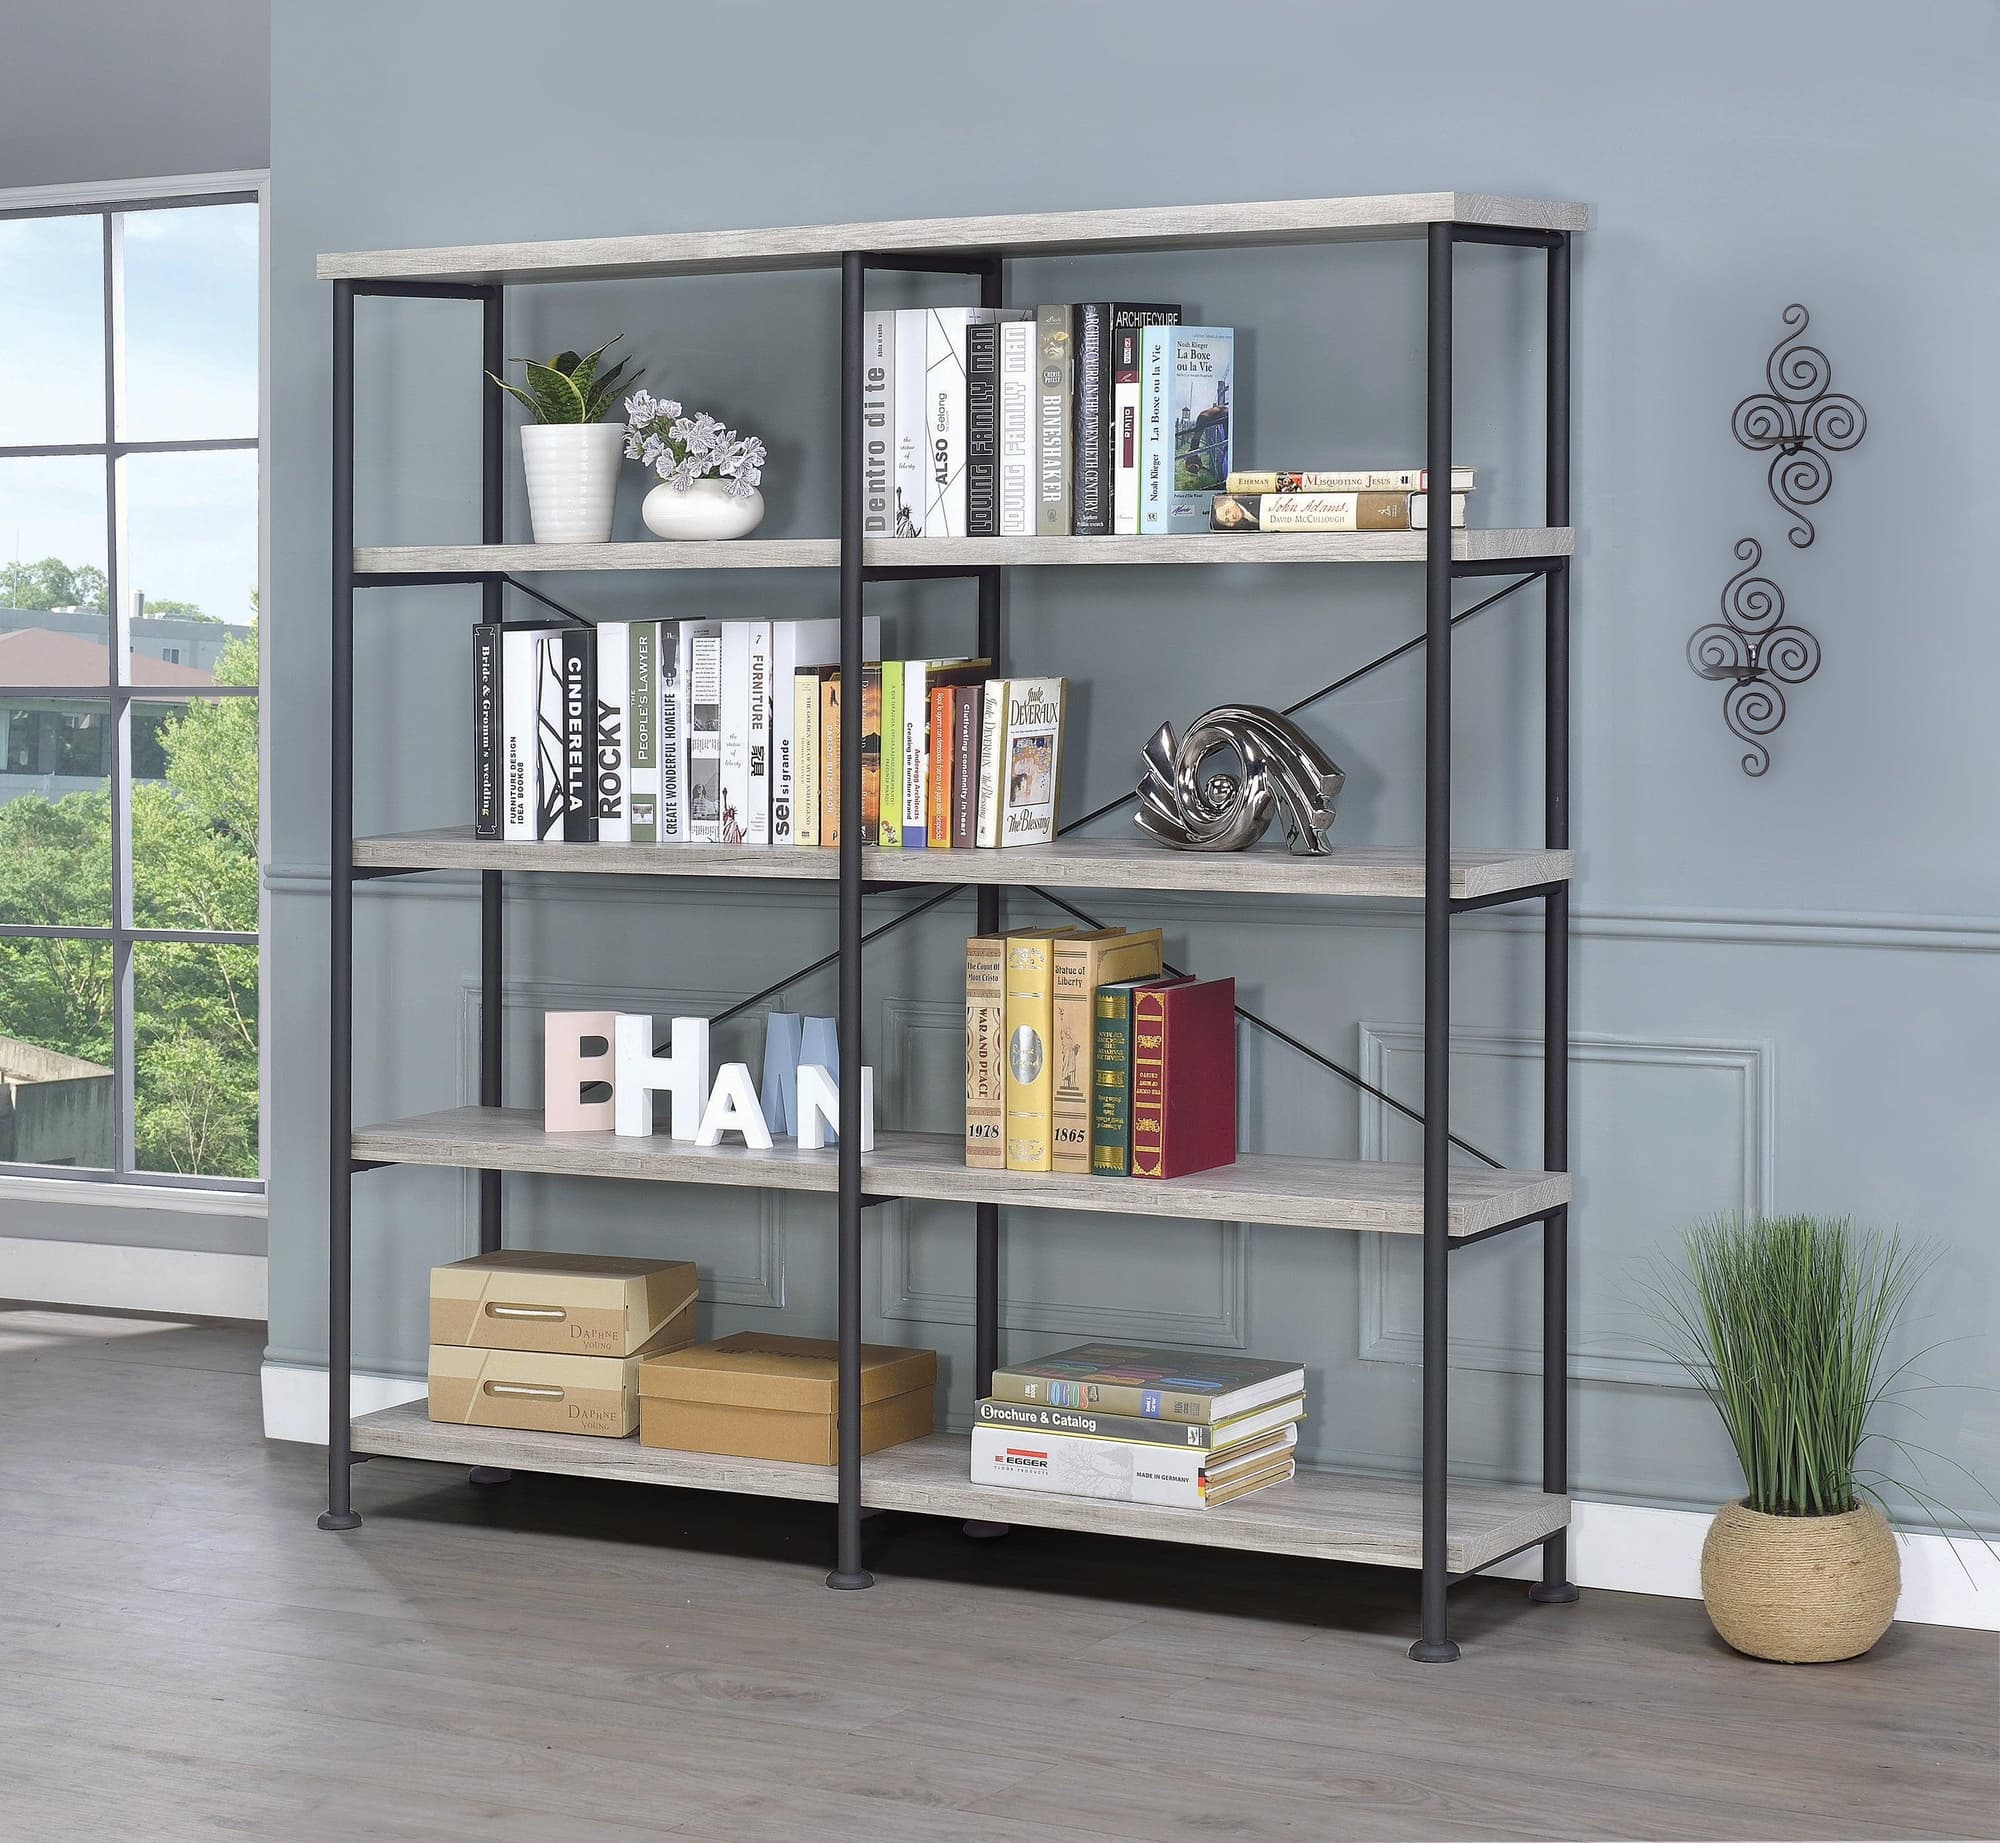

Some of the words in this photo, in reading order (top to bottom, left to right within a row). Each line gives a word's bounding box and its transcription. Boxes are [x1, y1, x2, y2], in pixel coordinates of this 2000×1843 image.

[970, 327, 994, 373] MAN
[1004, 327, 1026, 373] MAN
[1151, 344, 1161, 362] Vie
[1176, 340, 1191, 348] Noah
[1177, 349, 1188, 359] La
[1190, 349, 1211, 360] Boxe
[1152, 366, 1161, 376] la
[1176, 363, 1188, 371] ou
[1190, 361, 1197, 371] la
[1199, 361, 1213, 372] Vie
[864, 367, 886, 392] te
[1085, 384, 1099, 396] IN
[1153, 378, 1161, 393] ou
[864, 401, 885, 428] di
[1085, 396, 1099, 414] THE
[1151, 396, 1161, 423] Boxe
[970, 382, 993, 456] FAMILY
[1004, 381, 1026, 455] FAMILY
[1084, 414, 1099, 468] TWENTIETH
[1151, 427, 1160, 441] La
[1042, 394, 1061, 503] BONESHAKER
[935, 438, 948, 485] ALSO
[1150, 453, 1161, 479] Klieger
[864, 440, 886, 531] Dentro
[1084, 469, 1099, 513] CENTURY
[1150, 480, 1159, 502] Noah
[1304, 474, 1363, 486] MISQUOTING
[1365, 475, 1391, 487] JESUS
[1268, 497, 1298, 512] John
[1270, 514, 1293, 523] DAVID
[756, 634, 762, 645] 7
[481, 645, 491, 683] Bride
[637, 636, 648, 692] LAWYER
[482, 685, 491, 697] &
[752, 654, 764, 730] FURNITURE
[1026, 687, 1045, 704] Jude
[664, 693, 675, 738] HOMELIFE
[1010, 699, 1059, 726] DEVERAUX
[568, 657, 583, 811] CINDERELLA
[638, 695, 648, 760] PEOPLE'S
[599, 699, 622, 819] ROCKY
[664, 741, 677, 800] WONDERFUL
[780, 739, 791, 781] grande
[480, 763, 491, 816] wedding
[961, 801, 968, 810] in
[665, 802, 678, 835] CREATE
[1006, 813, 1021, 833] The
[1020, 809, 1051, 835] Blessing
[967, 962, 977, 970] The
[977, 962, 993, 970] Count
[1055, 965, 1077, 975] Statue
[1078, 966, 1086, 975] of
[982, 973, 999, 983] Cristo
[1057, 977, 1083, 988] Liberty
[978, 1008, 988, 1032] WAR
[978, 1034, 988, 1059] AND
[979, 1061, 988, 1097] PEACE
[968, 1123, 1000, 1139] 1978
[1054, 1127, 1086, 1143] 1865
[569, 1324, 619, 1341] DAPHNE
[583, 1340, 611, 1350] YOUNG
[568, 1404, 617, 1421] DAPHNE
[981, 1404, 1038, 1424] Brochure
[1040, 1411, 1050, 1424] &
[1052, 1413, 1097, 1432] Catalog
[581, 1421, 609, 1430] YOUNG
[993, 1464, 1015, 1472] FLOOR
[1017, 1467, 1049, 1476] PRODUCTS
[1006, 1456, 1048, 1468] EGGER
[1136, 1471, 1153, 1479] MADE
[1161, 1474, 1190, 1484] GERMANY
